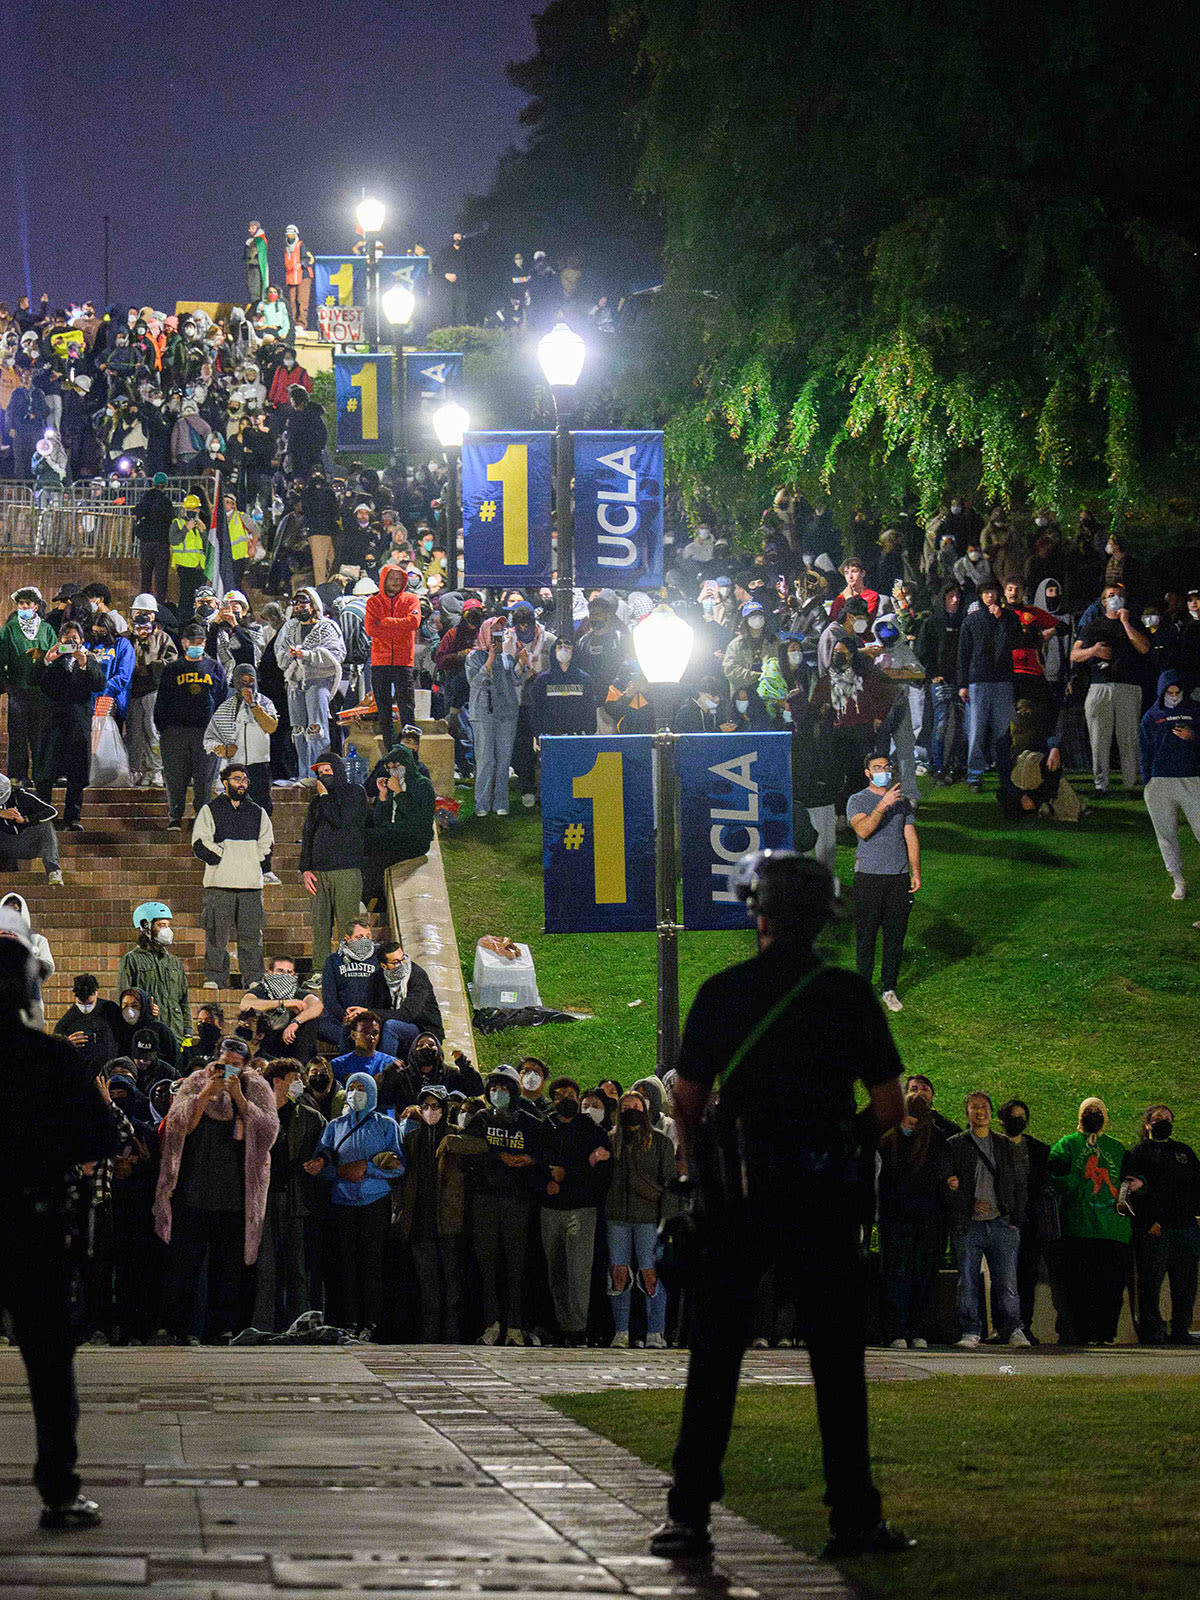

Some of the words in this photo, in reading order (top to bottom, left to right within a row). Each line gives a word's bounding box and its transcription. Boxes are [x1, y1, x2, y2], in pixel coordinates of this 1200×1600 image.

[319, 309, 363, 322] DIVEST
[319, 323, 362, 341] NOW
[346, 362, 379, 440] #1
[478, 444, 529, 566] #1
[596, 445, 638, 566] UCLA
[177, 672, 214, 686] UCLA
[563, 752, 627, 904] #1
[487, 1127, 524, 1140] UCLA
